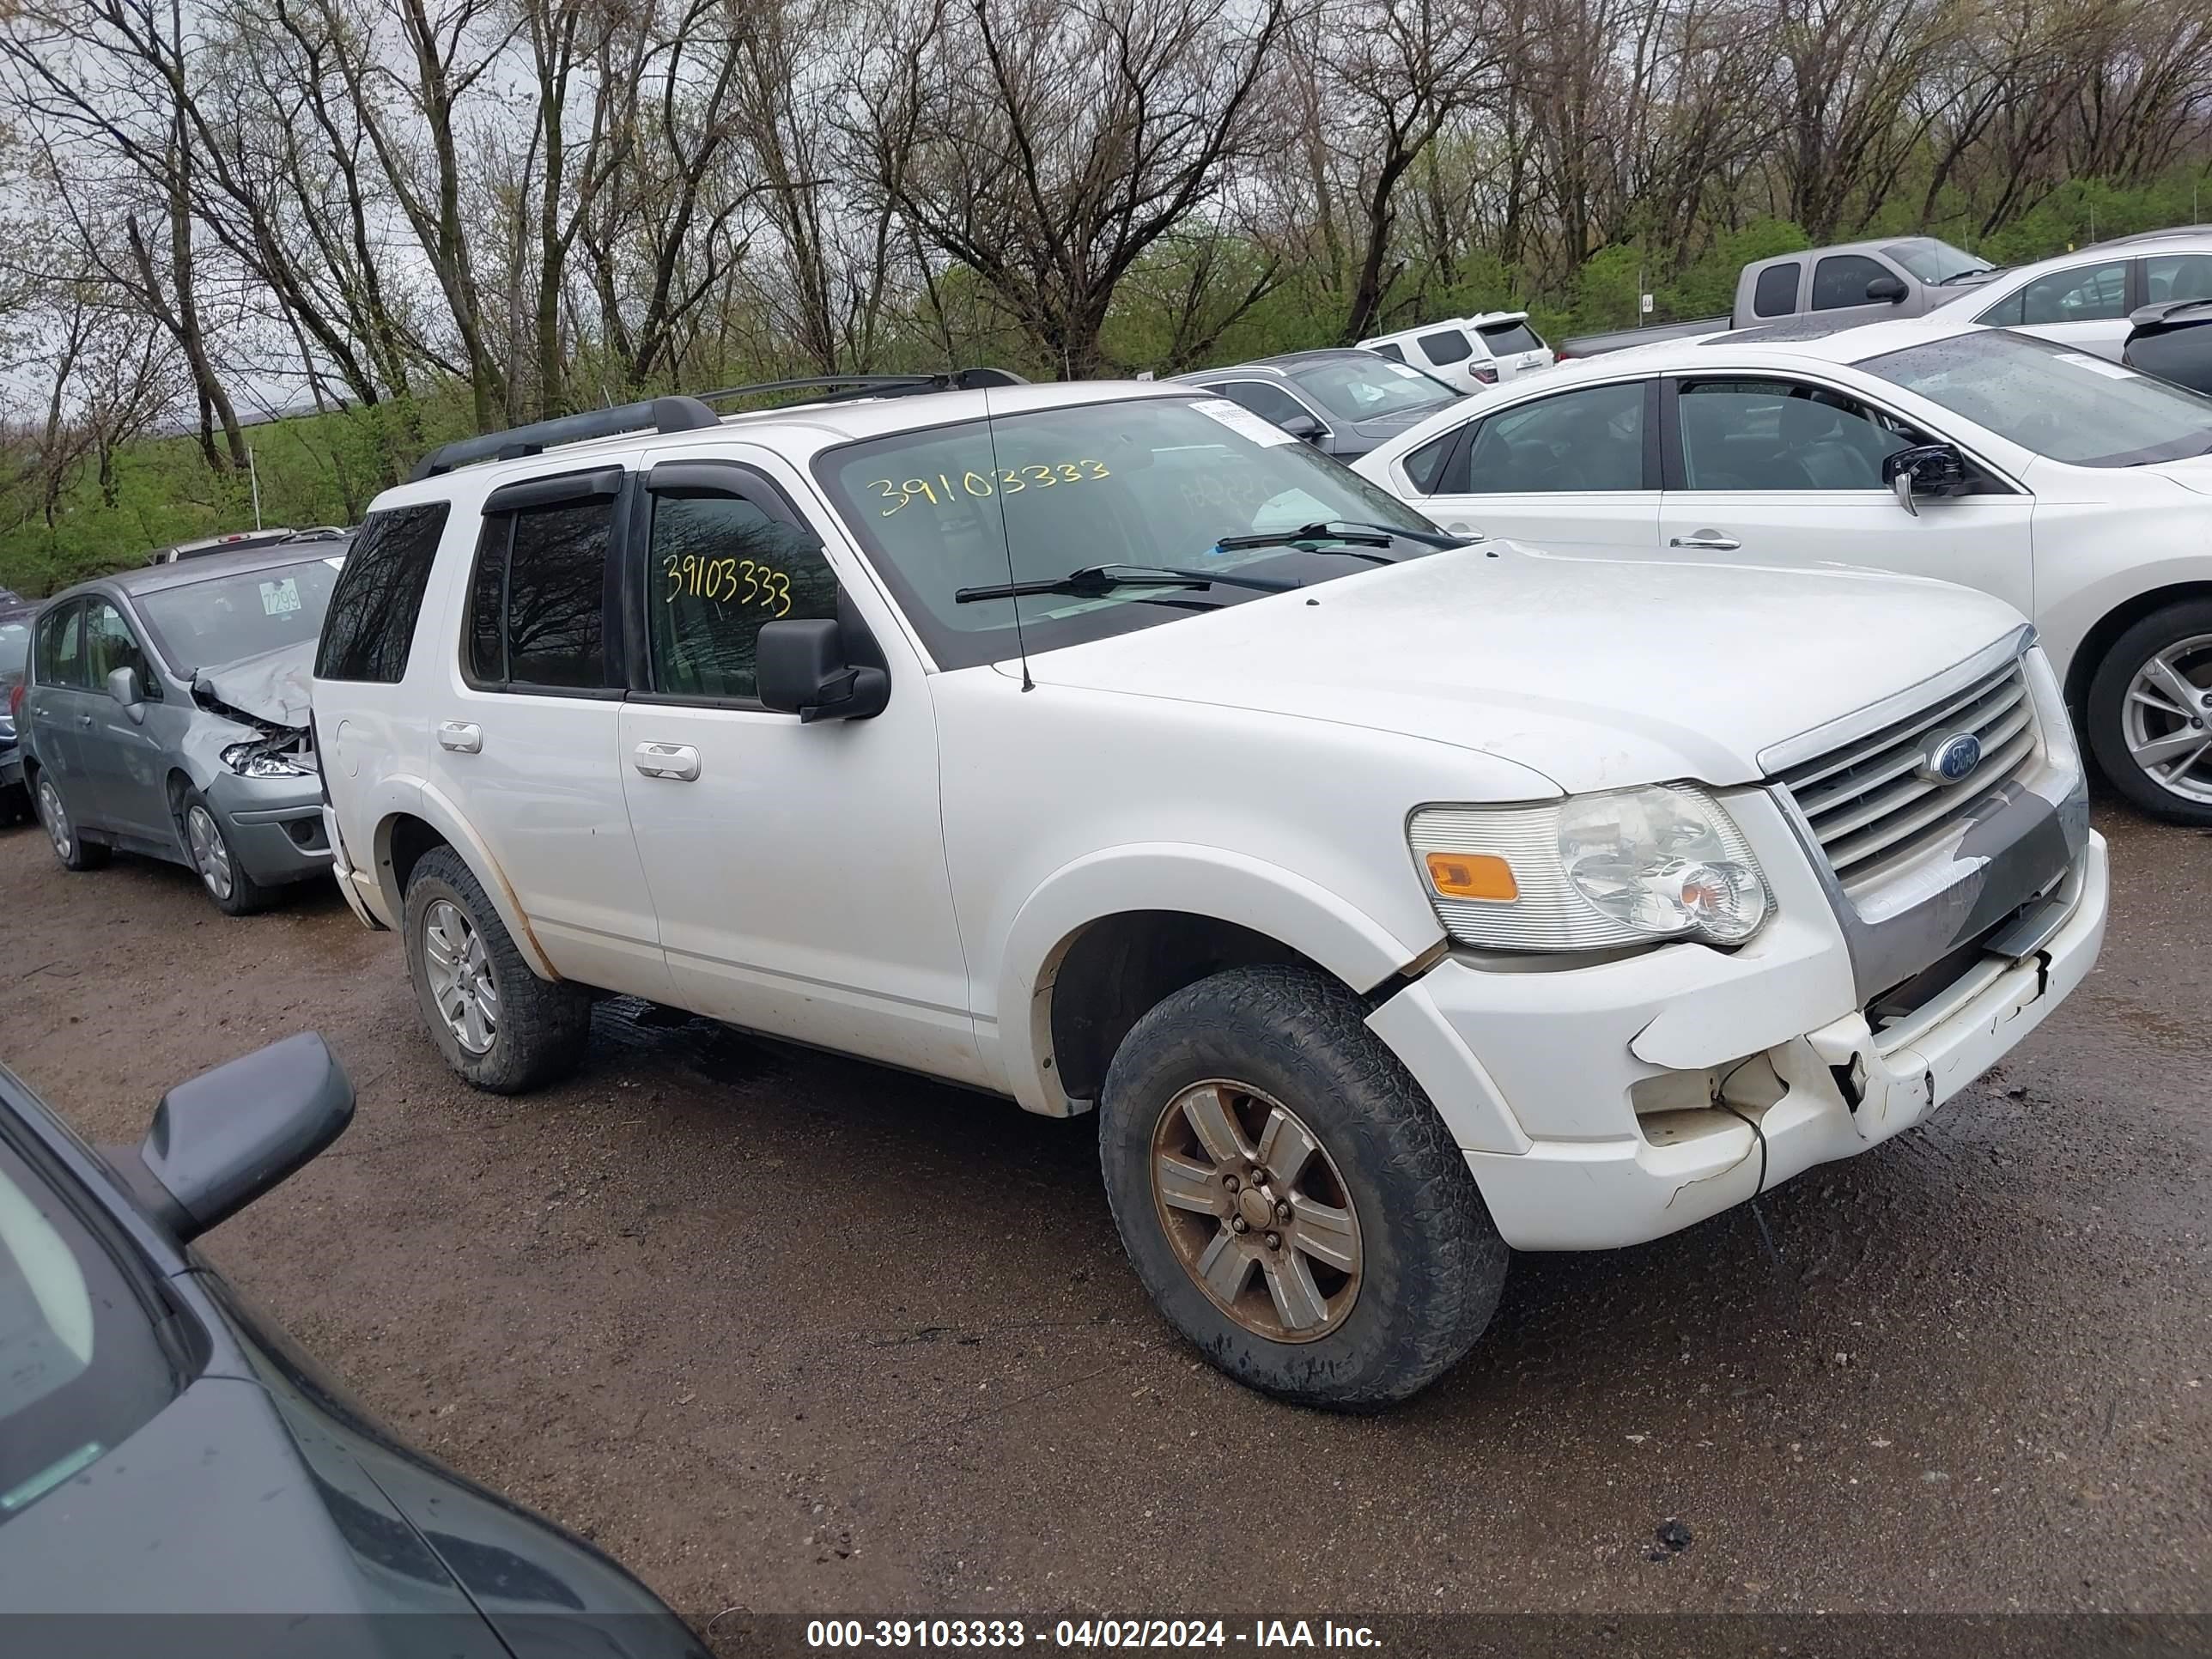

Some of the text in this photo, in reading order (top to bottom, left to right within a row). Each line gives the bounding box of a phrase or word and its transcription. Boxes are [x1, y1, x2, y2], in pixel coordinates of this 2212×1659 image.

[866, 459, 1110, 517] 39103333
[264, 590, 299, 613] 7299
[663, 555, 791, 618] 39103333
[1952, 743, 1975, 775] Ford
